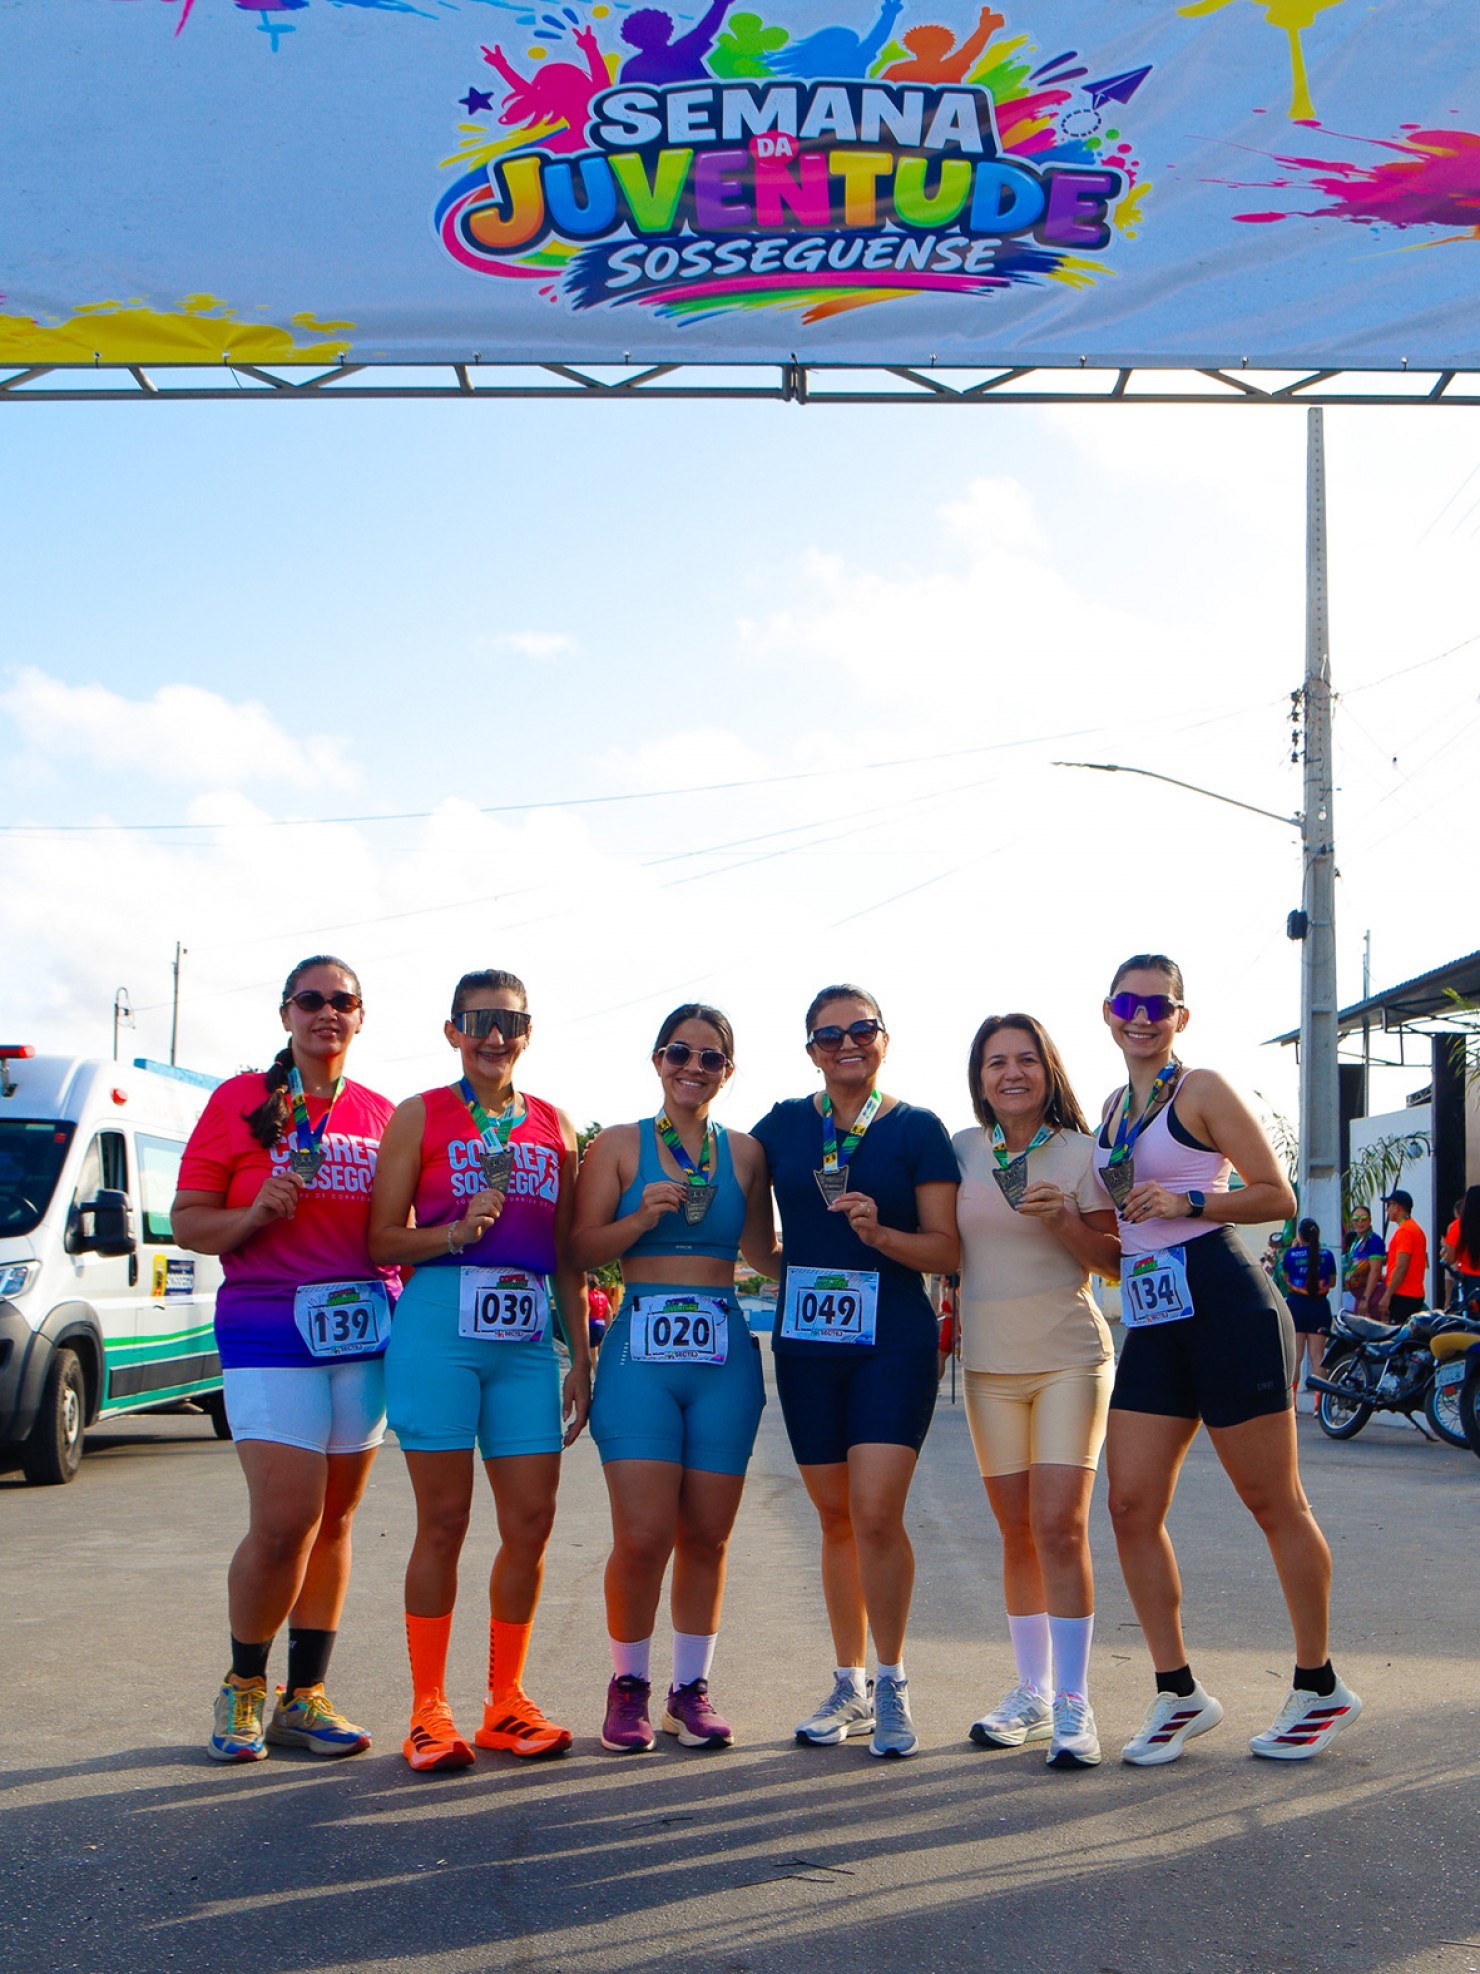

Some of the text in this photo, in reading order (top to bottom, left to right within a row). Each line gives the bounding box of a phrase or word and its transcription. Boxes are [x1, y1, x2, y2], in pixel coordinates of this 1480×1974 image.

[599, 88, 985, 155] SEMANA
[756, 136, 793, 158] DA
[468, 147, 1112, 246] JUVENTUDE
[605, 236, 1003, 289] SOSSEGUENSE
[448, 1139, 538, 1170] CORE
[481, 1293, 534, 1326] 039
[802, 1293, 856, 1326] 049
[1131, 1274, 1174, 1311] 134
[315, 1308, 369, 1343] 139
[653, 1316, 710, 1347] 020
